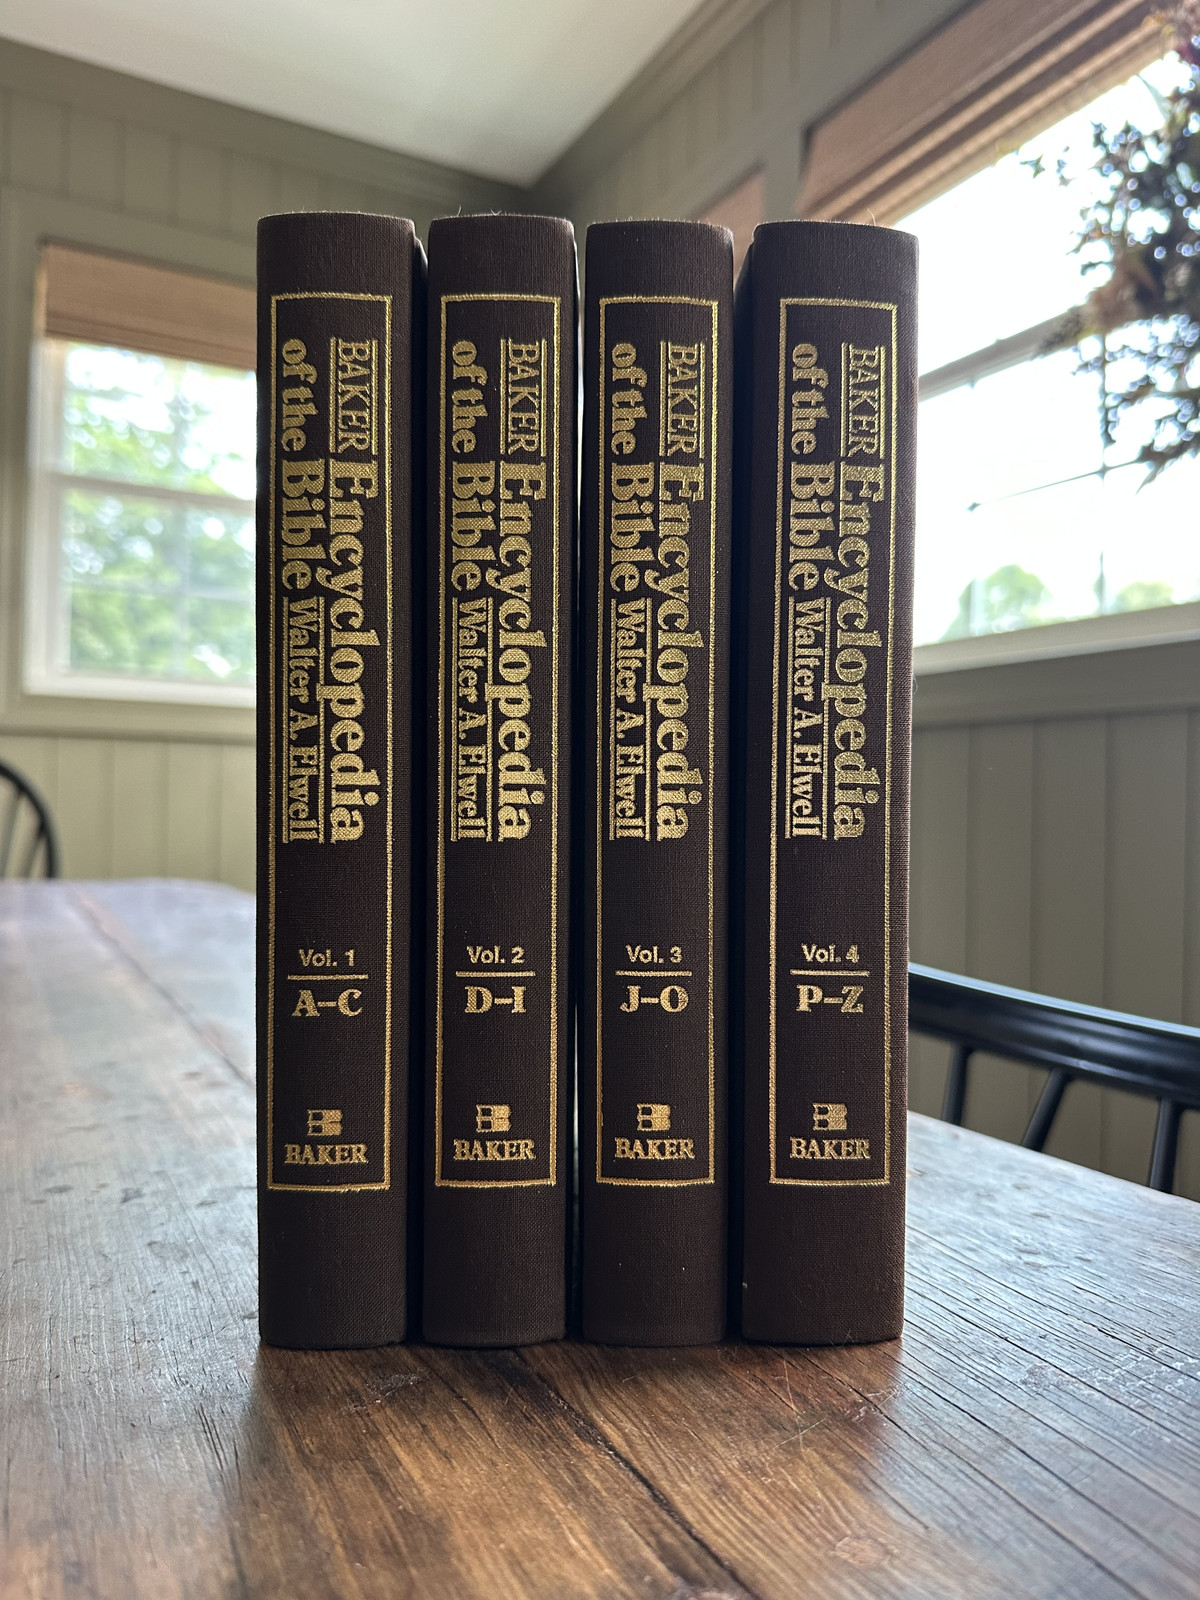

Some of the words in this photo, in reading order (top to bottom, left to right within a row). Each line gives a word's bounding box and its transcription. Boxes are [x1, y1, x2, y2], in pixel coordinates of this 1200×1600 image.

[282, 338, 317, 384] of
[338, 339, 371, 453] BAKER
[452, 340, 488, 386] of
[508, 338, 540, 454] BAKER
[611, 343, 648, 388] of
[667, 342, 699, 456] BAKER
[792, 343, 829, 389] of
[848, 344, 879, 457] BAKER
[282, 387, 318, 451] the
[451, 387, 488, 453] the
[611, 389, 648, 455] the
[791, 390, 830, 455] the
[282, 459, 326, 590] Bible
[451, 461, 496, 591] Bible
[610, 462, 655, 592] Bible
[789, 461, 835, 591] Bible
[289, 597, 319, 703] Walter
[315, 459, 380, 843] Encyclopedia
[458, 597, 487, 703] Walter
[485, 461, 547, 842] Encyclopedia
[616, 597, 646, 703] Walter
[642, 462, 704, 841] Encyclopedia
[794, 597, 825, 703] Walter
[822, 461, 884, 841] Encyclopedia
[289, 745, 319, 840] Elwell
[457, 745, 486, 839] Elwell
[615, 744, 645, 838] Elwell
[791, 743, 823, 837] Elwell
[299, 949, 337, 967] Vol.
[345, 950, 355, 967] 1
[467, 945, 505, 964] Vol.
[511, 946, 526, 964] 2
[626, 944, 664, 964] Vol.
[670, 946, 682, 963] 3
[801, 943, 842, 963] Vol.
[845, 944, 859, 964] 4
[284, 1143, 369, 1165] BAKER
[453, 1139, 536, 1161] BAKER
[614, 1137, 695, 1160] BAKER
[789, 1137, 870, 1160] BAKER
